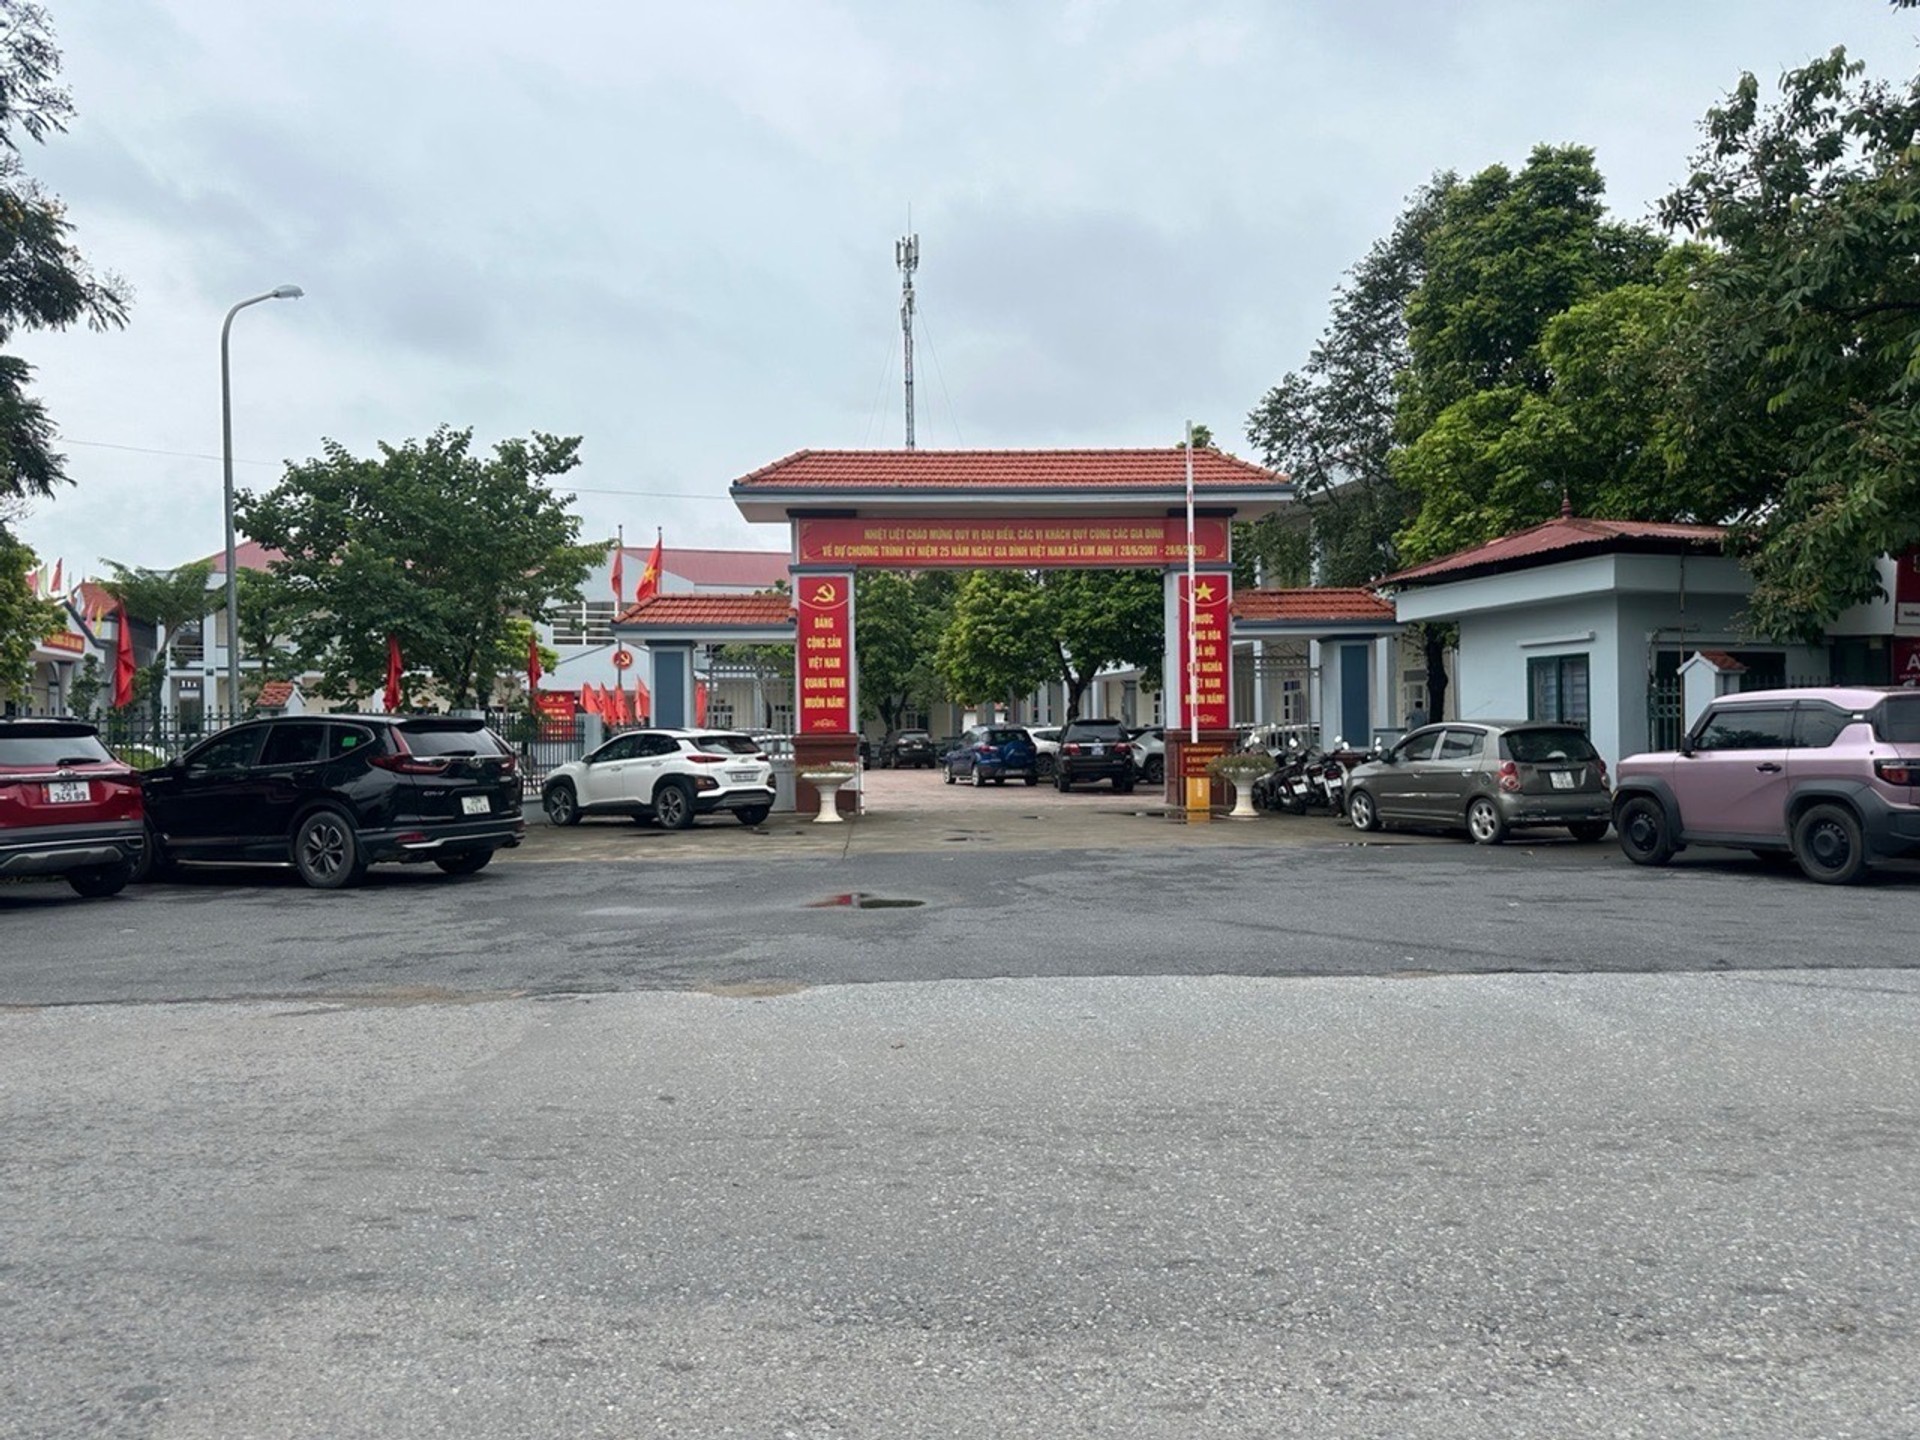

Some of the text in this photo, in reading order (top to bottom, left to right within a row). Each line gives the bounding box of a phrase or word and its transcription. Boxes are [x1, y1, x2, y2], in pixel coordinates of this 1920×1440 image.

[939, 546, 950, 556] 25
[993, 546, 1008, 556] GIA
[1029, 544, 1046, 558] VIỆT
[1047, 546, 1065, 556] NAM
[1080, 546, 1095, 556] KIM
[814, 615, 834, 628] ĐẢNG
[806, 635, 842, 649] CỘNG SẢN
[808, 656, 840, 669] VIỆT NAM
[804, 677, 845, 689] QUANG VINH
[1205, 678, 1220, 688] NAM
[804, 696, 825, 708] MUÔN
